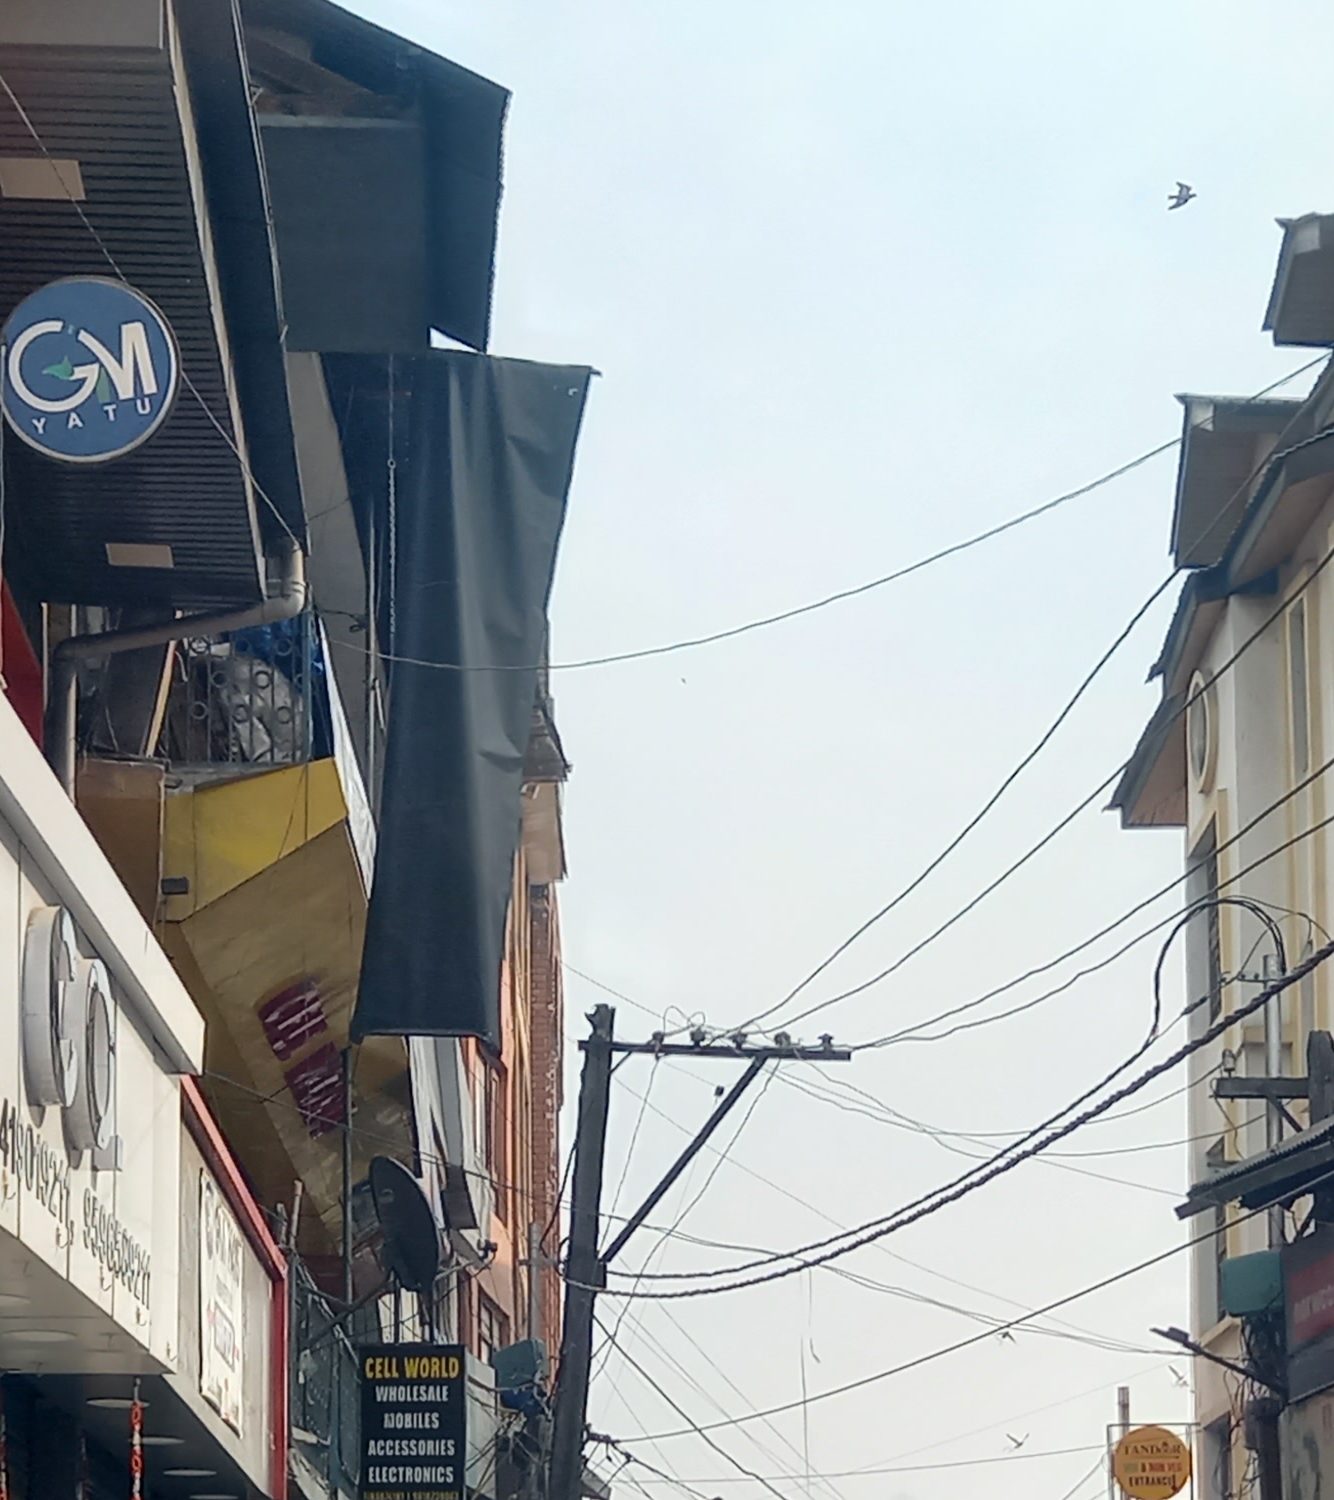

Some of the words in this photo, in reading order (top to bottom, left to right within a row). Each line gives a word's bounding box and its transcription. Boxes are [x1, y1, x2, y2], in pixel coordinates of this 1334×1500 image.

[8, 319, 159, 414] GM
[31, 398, 153, 436] YATU
[364, 1356, 400, 1380] CELL
[403, 1356, 460, 1380] WORLD
[375, 1385, 449, 1403] WHOLESALE
[383, 1412, 440, 1430] MOBILES
[367, 1439, 456, 1457] ACCESSORIES
[367, 1466, 455, 1484] ELECTRONICS
